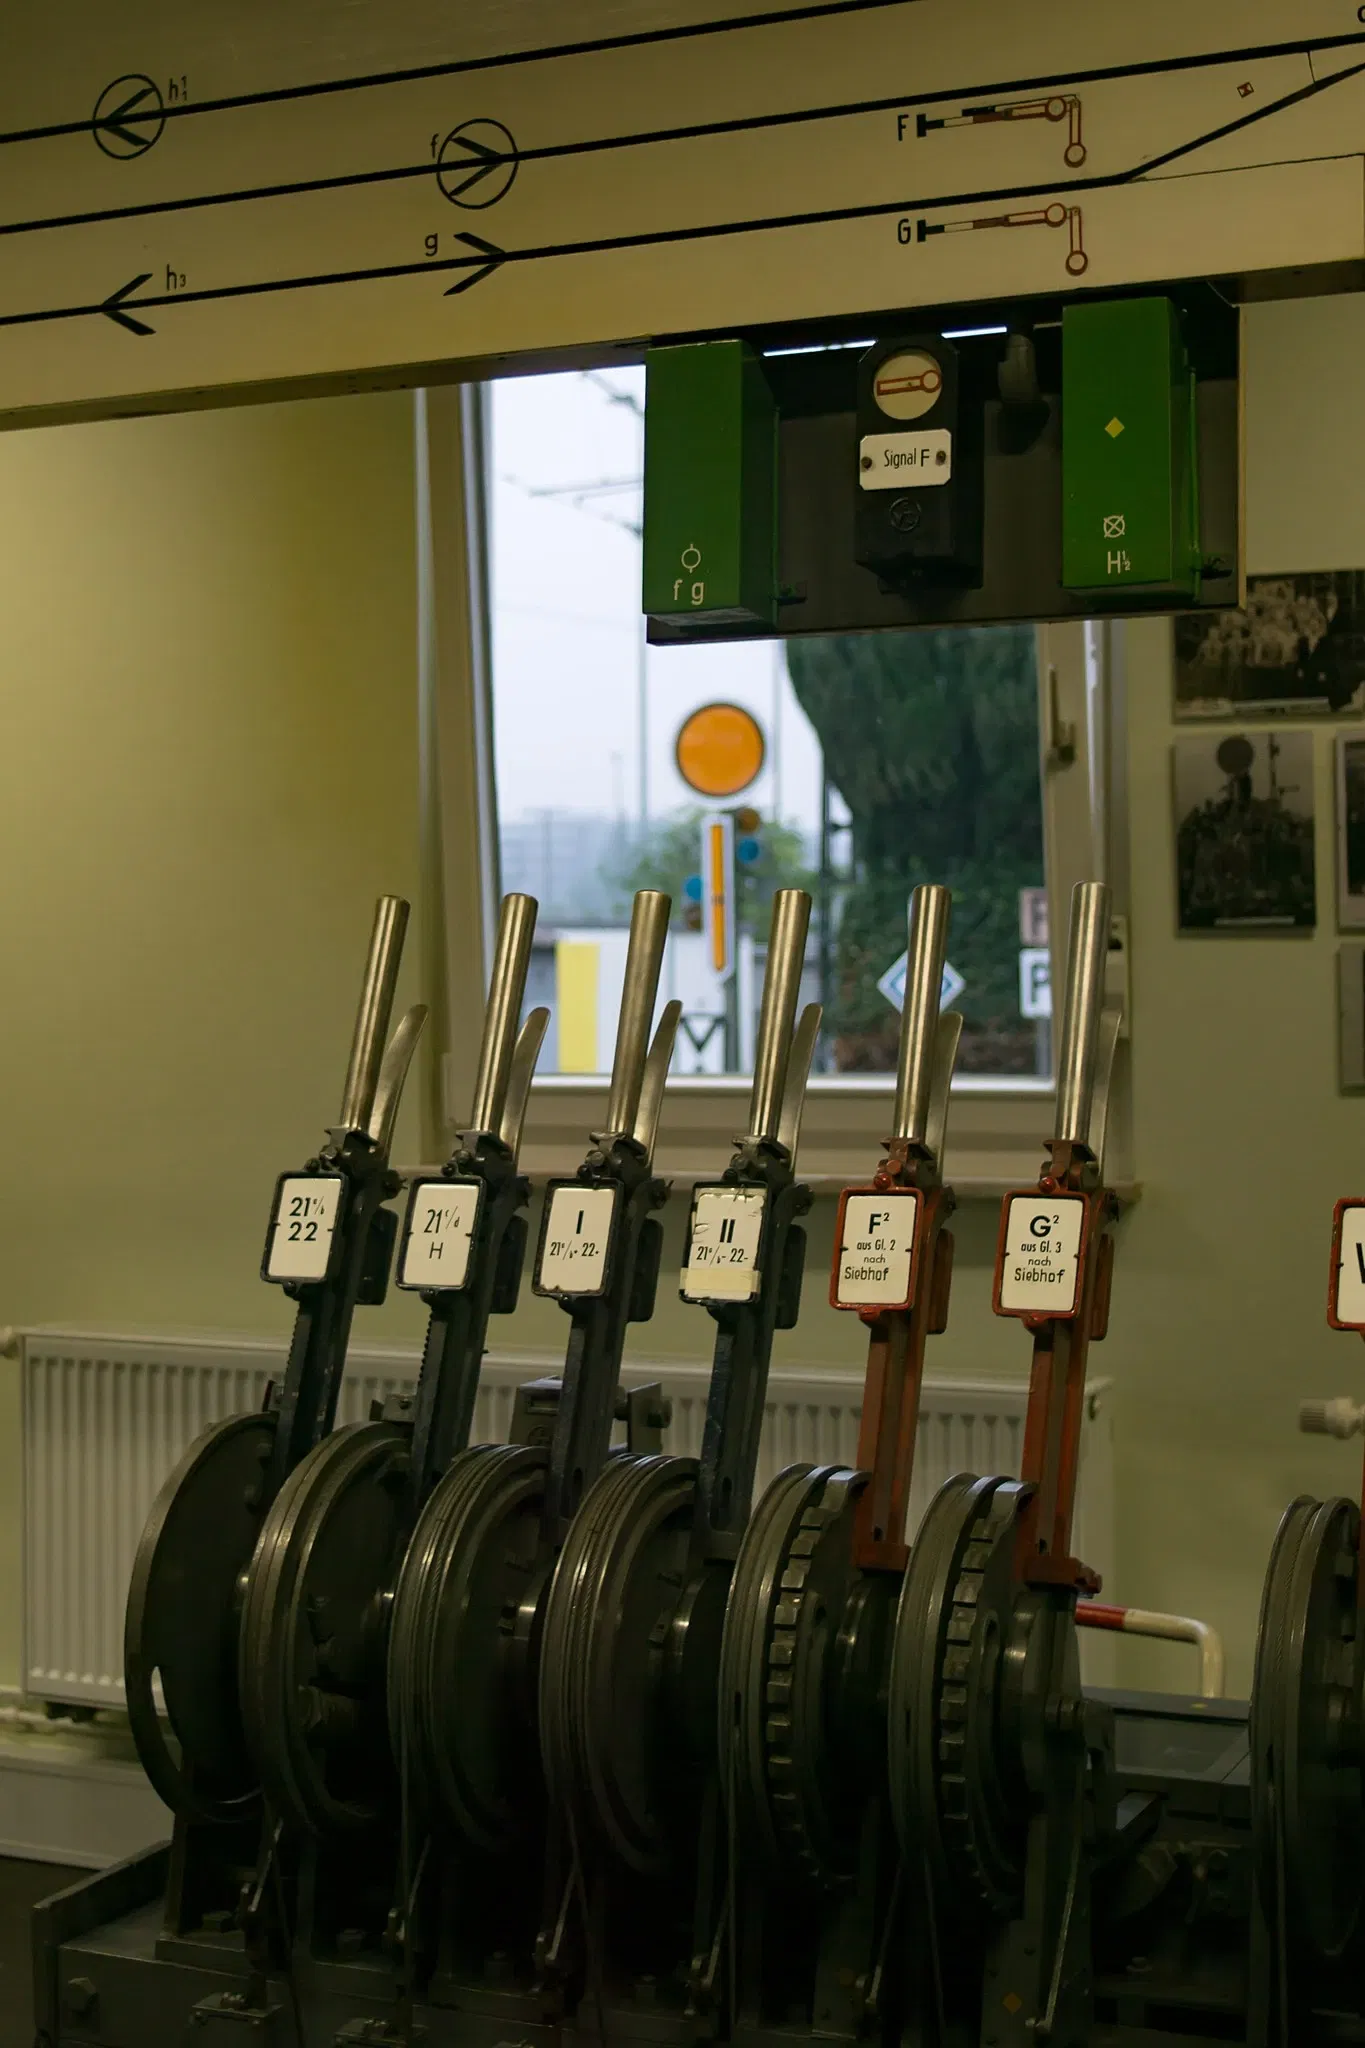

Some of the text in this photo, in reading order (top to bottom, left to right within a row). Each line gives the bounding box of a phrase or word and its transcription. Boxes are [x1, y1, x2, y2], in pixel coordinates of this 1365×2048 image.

[897, 114, 909, 141] F
[430, 133, 439, 158] f
[897, 218, 911, 245] G
[424, 232, 438, 257] g
[883, 447, 930, 470] Signal F
[673, 578, 705, 606] f g
[288, 1221, 318, 1242] 22
[428, 1241, 444, 1260] H
[856, 1238, 896, 1251] aus Gl. 2
[1020, 1240, 1062, 1254] aus Gl. 3
[863, 1253, 886, 1264] nach
[1028, 1256, 1051, 1267] nach
[844, 1266, 889, 1281] Siebhof
[1014, 1267, 1065, 1284] Siebhof
